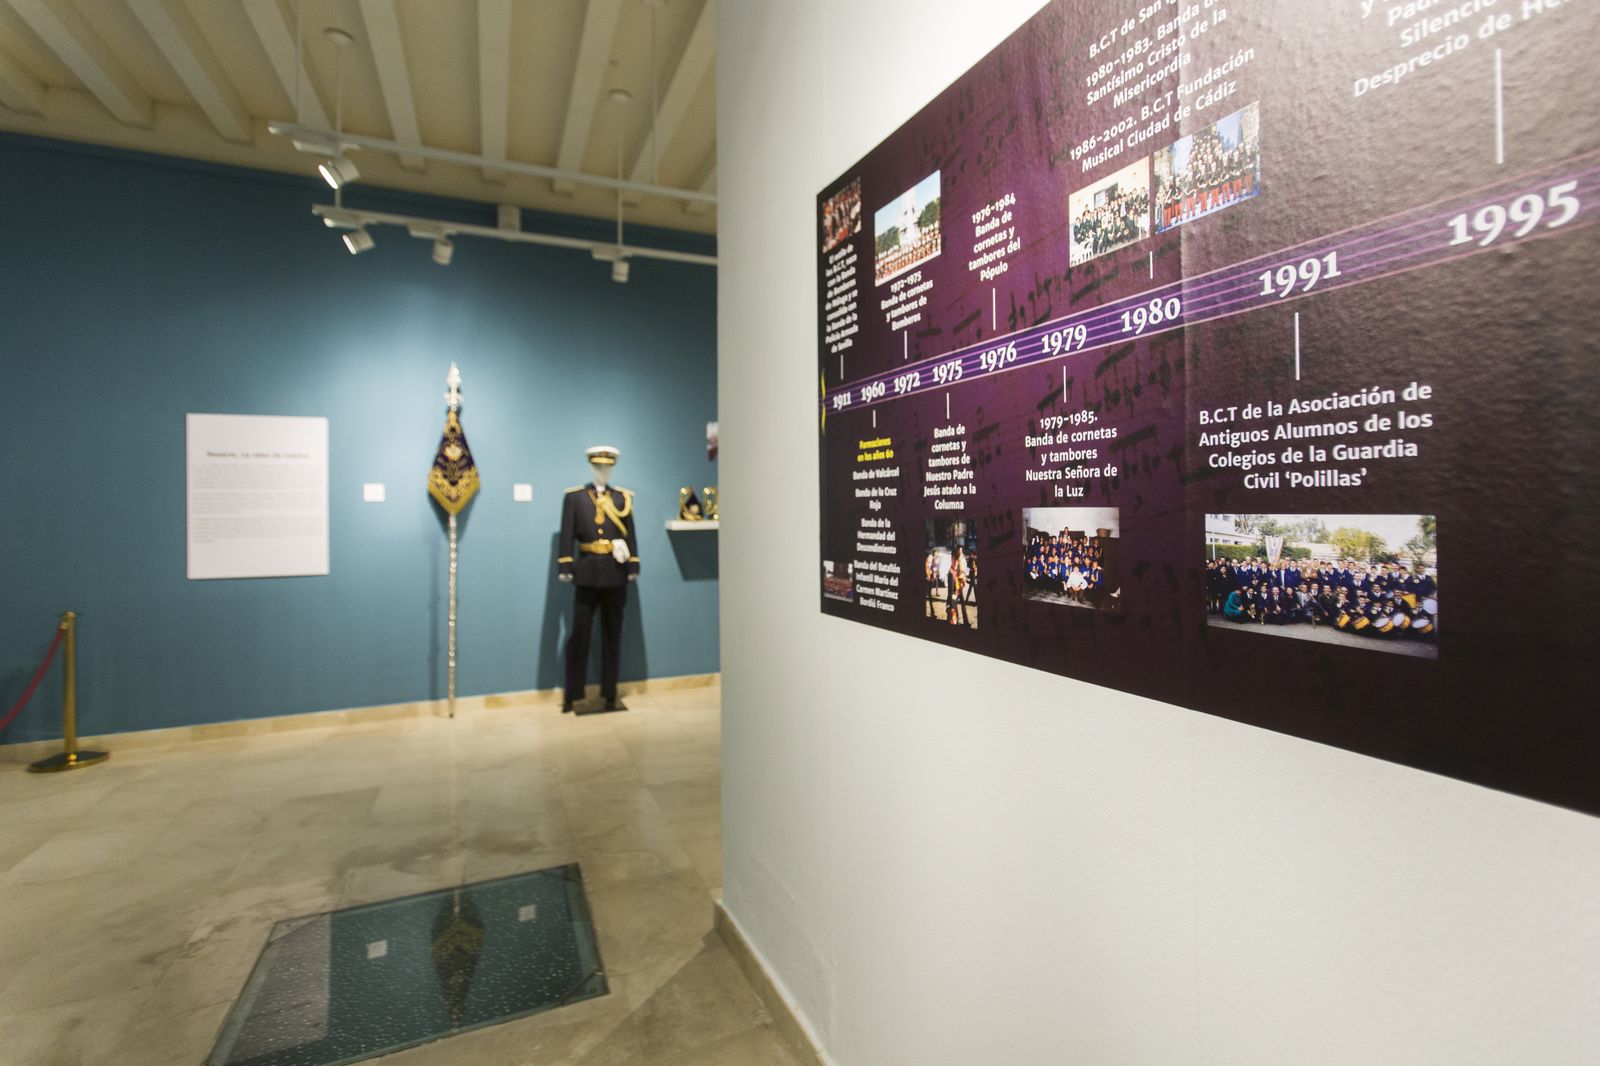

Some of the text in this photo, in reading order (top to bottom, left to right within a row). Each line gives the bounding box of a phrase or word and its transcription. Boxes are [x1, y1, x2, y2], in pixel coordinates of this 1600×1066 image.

[1089, 0, 1162, 59] B.C.T de San
[1086, 4, 1199, 88] 1980-1983. Banda
[1086, 8, 1227, 106] Santísimo Cristo de la
[1353, 13, 1512, 98] Desprecio de
[1113, 52, 1191, 108] Misericordia
[1070, 48, 1255, 161] 1986-2002. B.C.T Fundación
[1082, 80, 1236, 173] Musical Ciudad de Cádiz
[972, 193, 1016, 224] 1976-1984
[976, 210, 1012, 237] Banda de
[973, 226, 1014, 253] cornetas y
[968, 236, 1020, 271] tambores del
[980, 261, 1008, 282] Pópulo
[833, 180, 1580, 410] 1911 1960 1972 1975 1976 1979 1980 1991 1995
[881, 280, 933, 310] Banda de cornetas
[886, 295, 927, 323] y tambores de
[892, 312, 921, 331] Bomberos
[1200, 382, 1432, 425] B.C.T de la Asociación de
[1040, 410, 1098, 430] 1979-1985.
[1199, 411, 1433, 447] Antiguos Alumnos de los
[934, 424, 965, 438] Banda de
[1025, 426, 1117, 448] Banda de cornetas
[859, 438, 891, 449] Formaciones
[931, 441, 966, 453] cornetas y
[886, 449, 894, 459] 60
[928, 453, 970, 467] tambores de
[1040, 448, 1098, 466] y tambores
[1209, 440, 1418, 470] Colegios de la Guardia
[853, 466, 900, 480] Banda de Valcárcel
[926, 468, 974, 482] Nuestro Padre
[1026, 463, 1118, 481] Nuestra Señora de
[1244, 472, 1280, 489] Civil
[855, 486, 897, 497] Banda de la Cruz
[924, 483, 976, 497] Jesús atado a la
[1054, 484, 1084, 497] la Luz
[869, 500, 881, 511] Roja
[935, 499, 964, 510] Columna
[861, 518, 890, 528] Banda de la
[857, 531, 895, 541] Hermandad del
[857, 542, 896, 554] Descendimiento
[890, 577, 898, 586] del
[856, 584, 898, 599] Carmen Martínez
[877, 600, 894, 612] Franco
